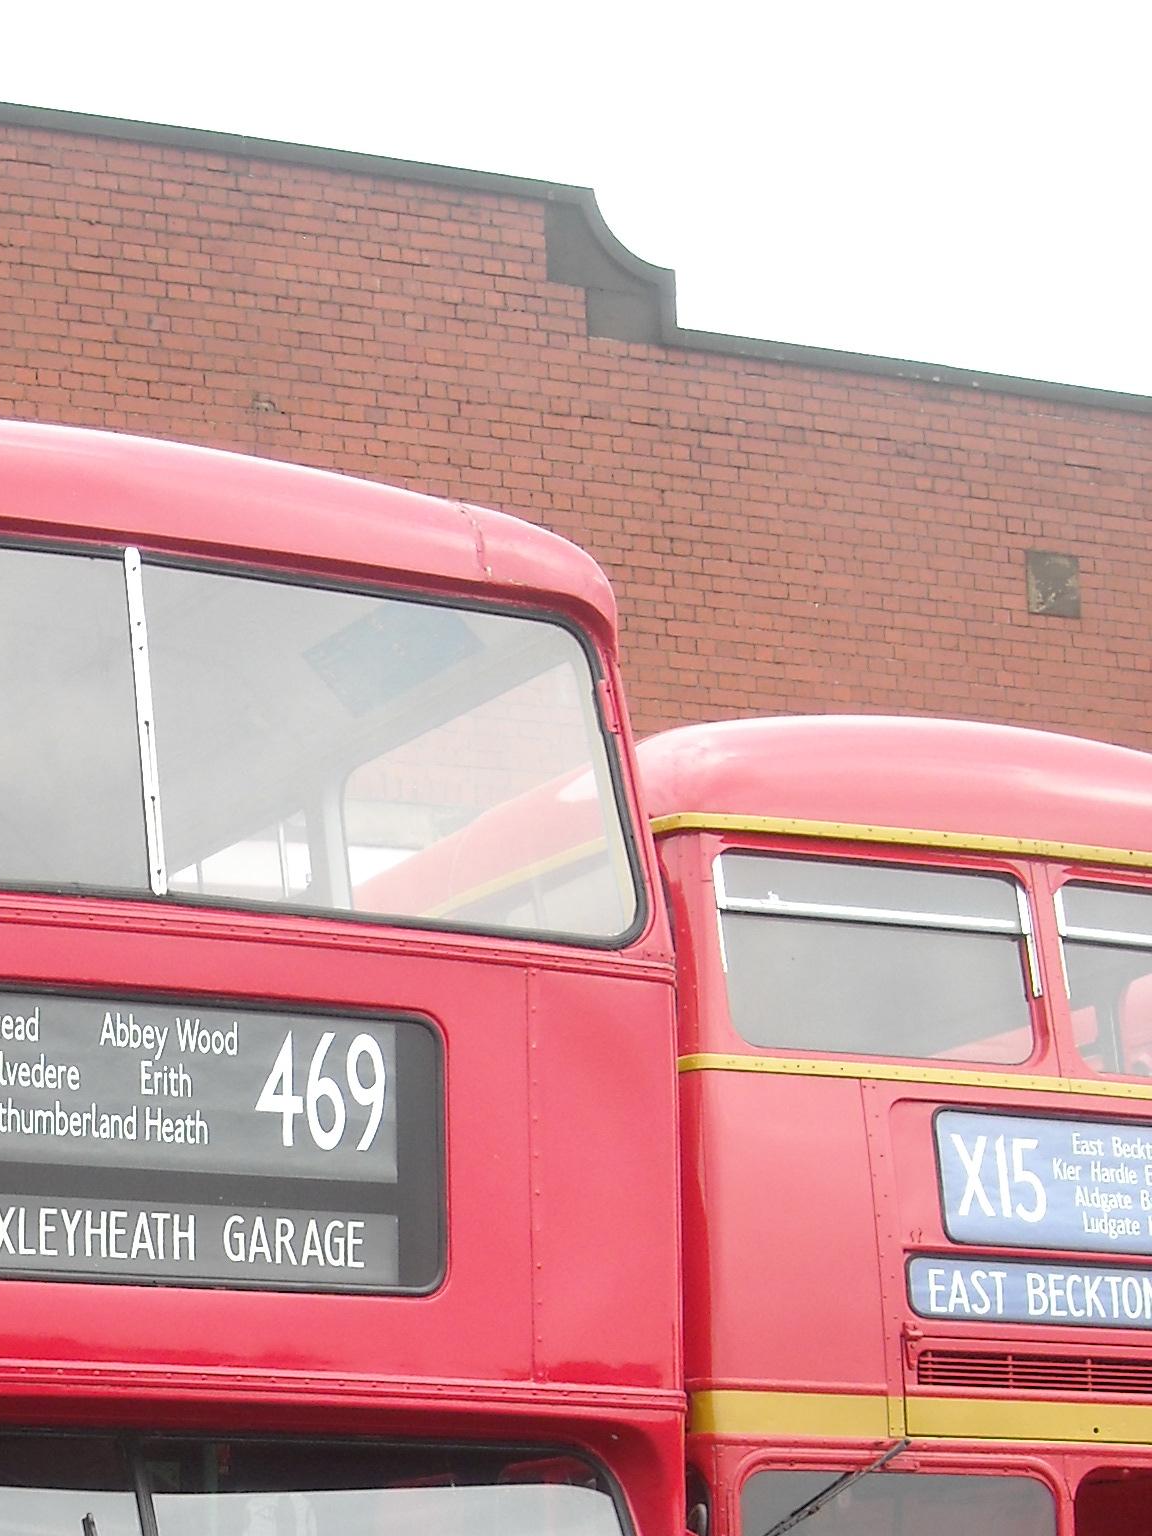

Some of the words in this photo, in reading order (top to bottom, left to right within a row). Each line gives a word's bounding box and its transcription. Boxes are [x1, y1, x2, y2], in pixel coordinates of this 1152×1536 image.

[99, 1012, 168, 1058] Abbey
[176, 1018, 238, 1056] Wood
[140, 1060, 192, 1098] Erith
[255, 1031, 386, 1151] 469
[144, 1109, 209, 1145] Heath
[1072, 1132, 1104, 1156] East
[950, 1133, 1047, 1223] X15
[1075, 1185, 1133, 1212] Aldgate
[224, 1214, 365, 1268] GARAGE
[1083, 1211, 1140, 1239] Ludgate
[928, 1268, 1007, 1314] EAST
